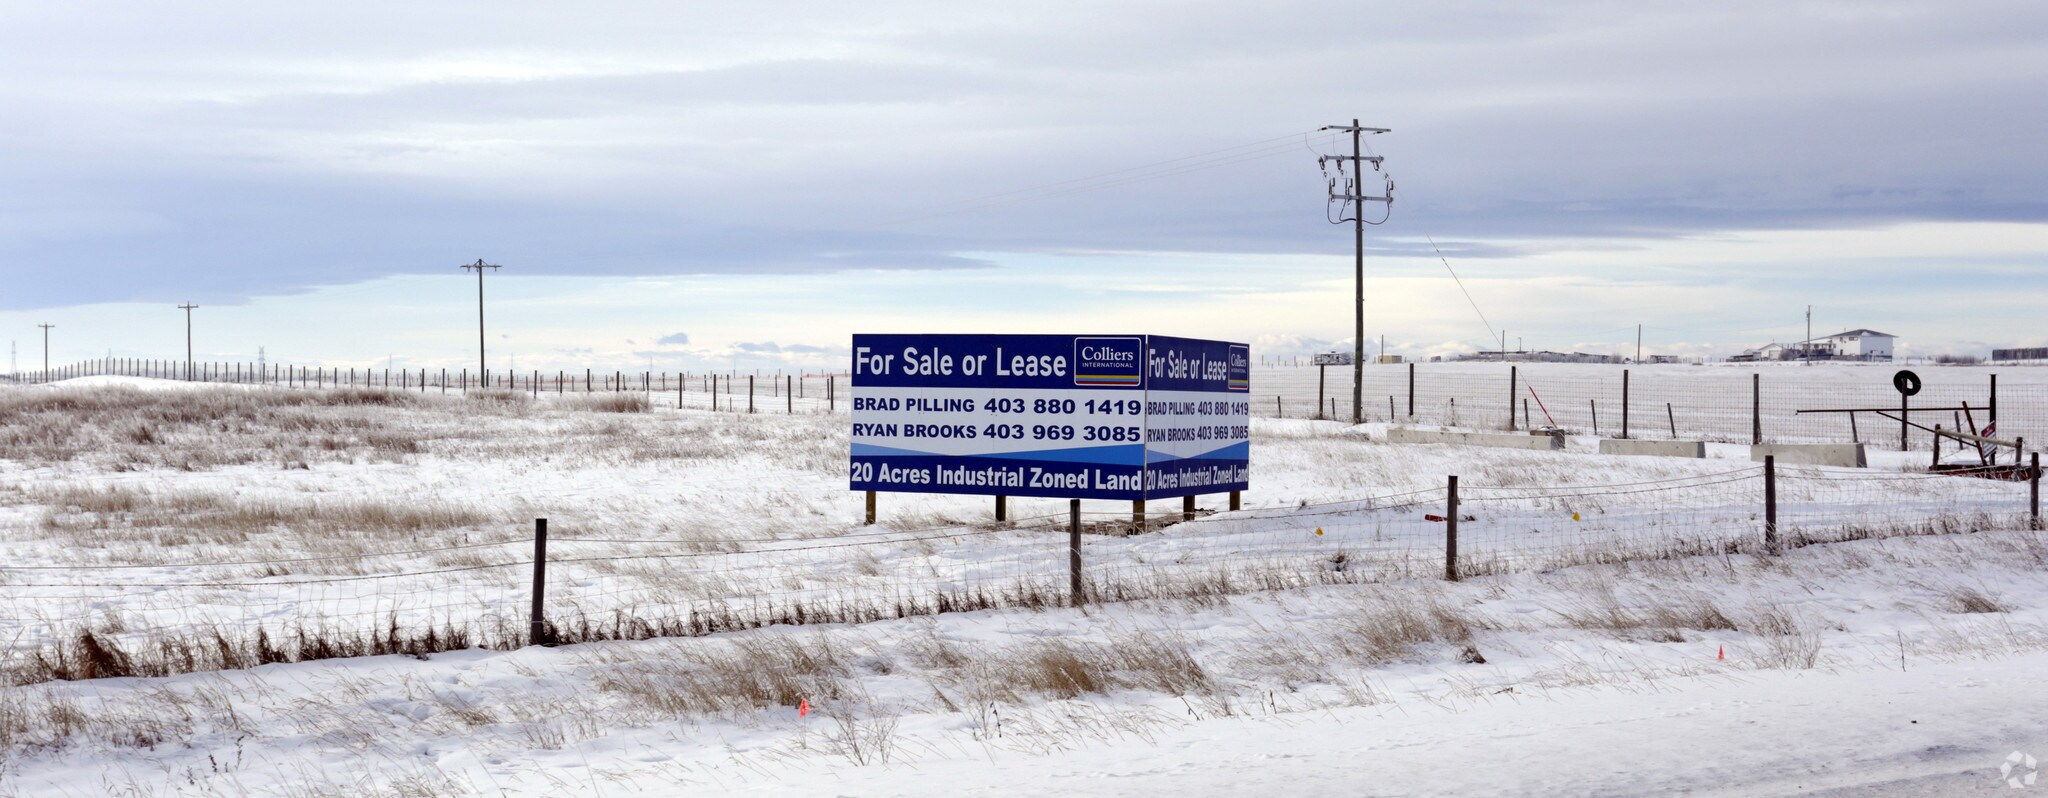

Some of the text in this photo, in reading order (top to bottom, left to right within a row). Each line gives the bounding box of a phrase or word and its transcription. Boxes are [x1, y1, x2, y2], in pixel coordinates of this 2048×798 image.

[856, 346, 1067, 377] For Sale or Lease
[1081, 346, 1134, 361] Colliers
[1148, 348, 1227, 381] For Sale or Lease
[853, 397, 1142, 416] BRAD PILLING 403 880 1419
[1147, 400, 1249, 416] BRAD PILLING 403 880 1419
[852, 423, 1141, 442] RYAN BROOKS 403 969 3085
[1147, 425, 1249, 443] RYAN BROOKS 403 969 3085
[851, 462, 1142, 491] 20 Acres Industrial Zoned Land
[1146, 462, 1249, 491] 20 Acres Industrial Zoned Land
